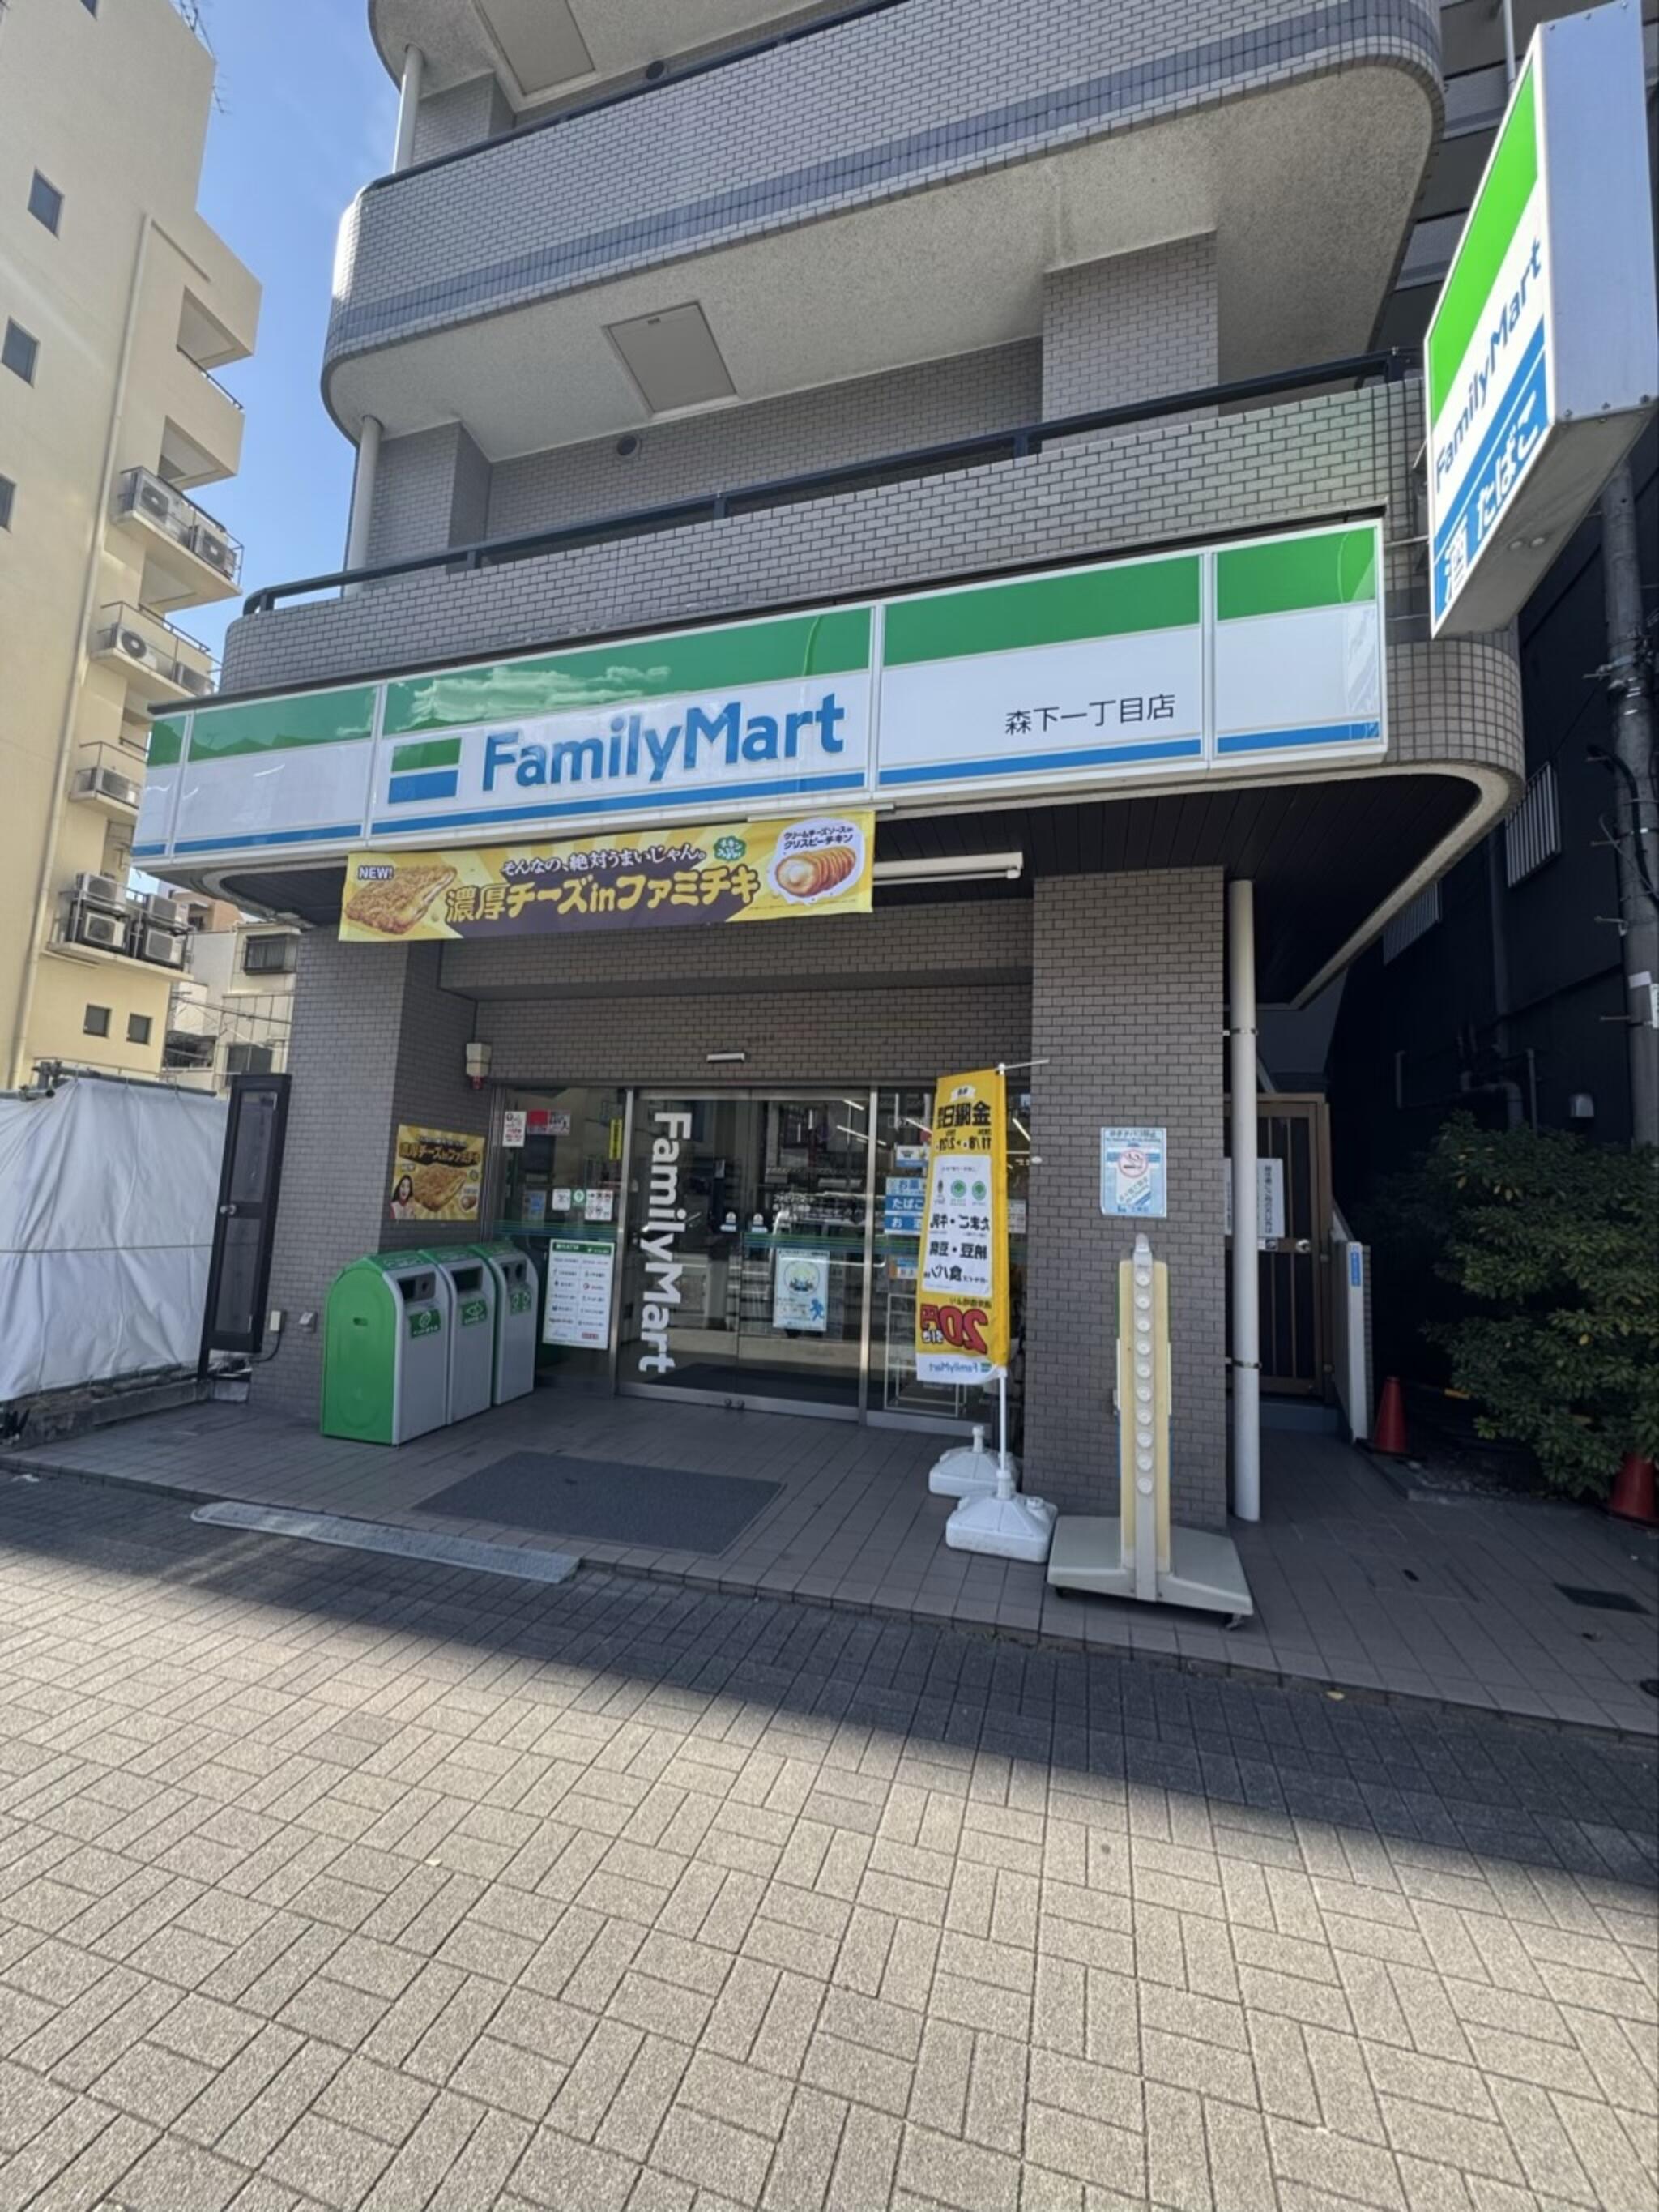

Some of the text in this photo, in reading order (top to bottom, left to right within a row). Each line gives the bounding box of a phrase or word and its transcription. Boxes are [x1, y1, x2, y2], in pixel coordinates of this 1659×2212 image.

[1435, 237, 1542, 493] FamilyMart
[1476, 391, 1539, 540] たばこ
[482, 693, 844, 791] FamilyMart
[1005, 694, 1175, 735] 森下一丁目店
[359, 865, 394, 881] NEW!
[502, 843, 707, 876] そんなの、絶対うまいじゃん。
[445, 864, 761, 924] 濃厚チーズinファミチキ
[892, 1198, 924, 1210] たばこ
[638, 1112, 692, 1373] FamilyMart
